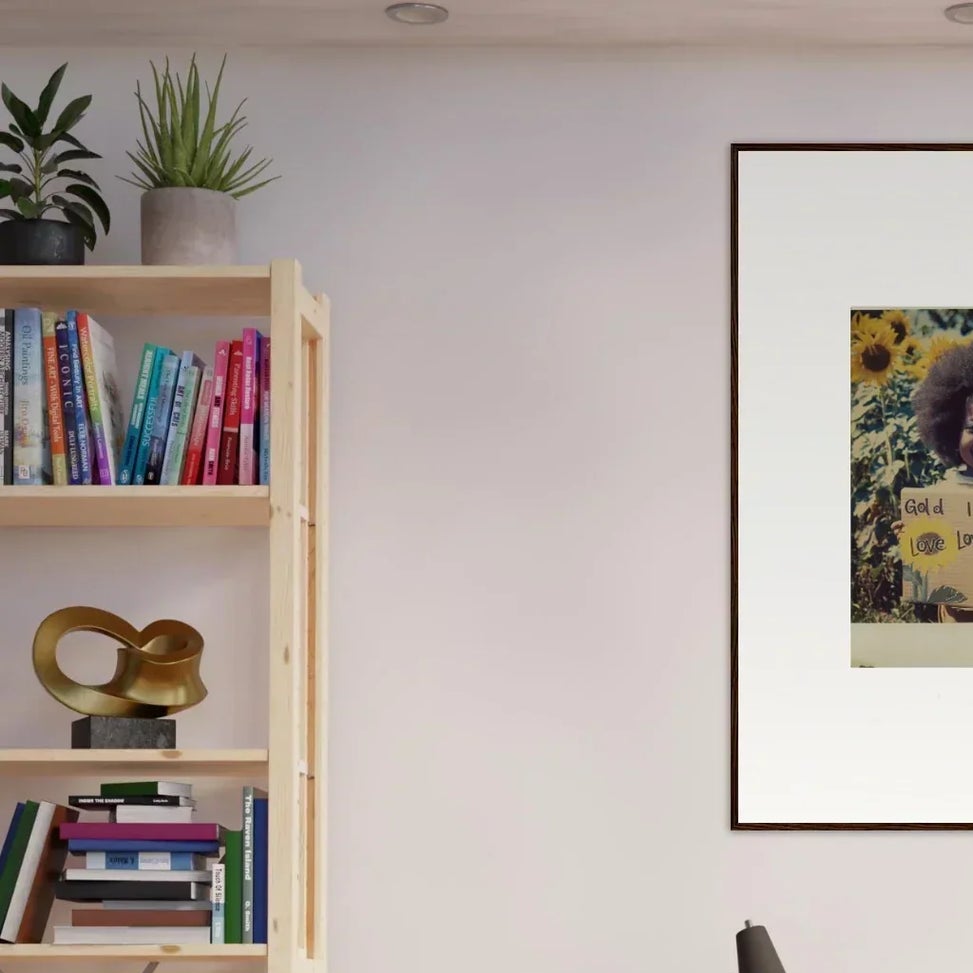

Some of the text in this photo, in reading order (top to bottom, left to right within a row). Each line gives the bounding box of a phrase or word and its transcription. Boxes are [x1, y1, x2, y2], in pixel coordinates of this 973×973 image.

[19, 343, 32, 385] Paintings
[904, 498, 945, 516] Gold
[244, 795, 252, 881] The Raven Island
